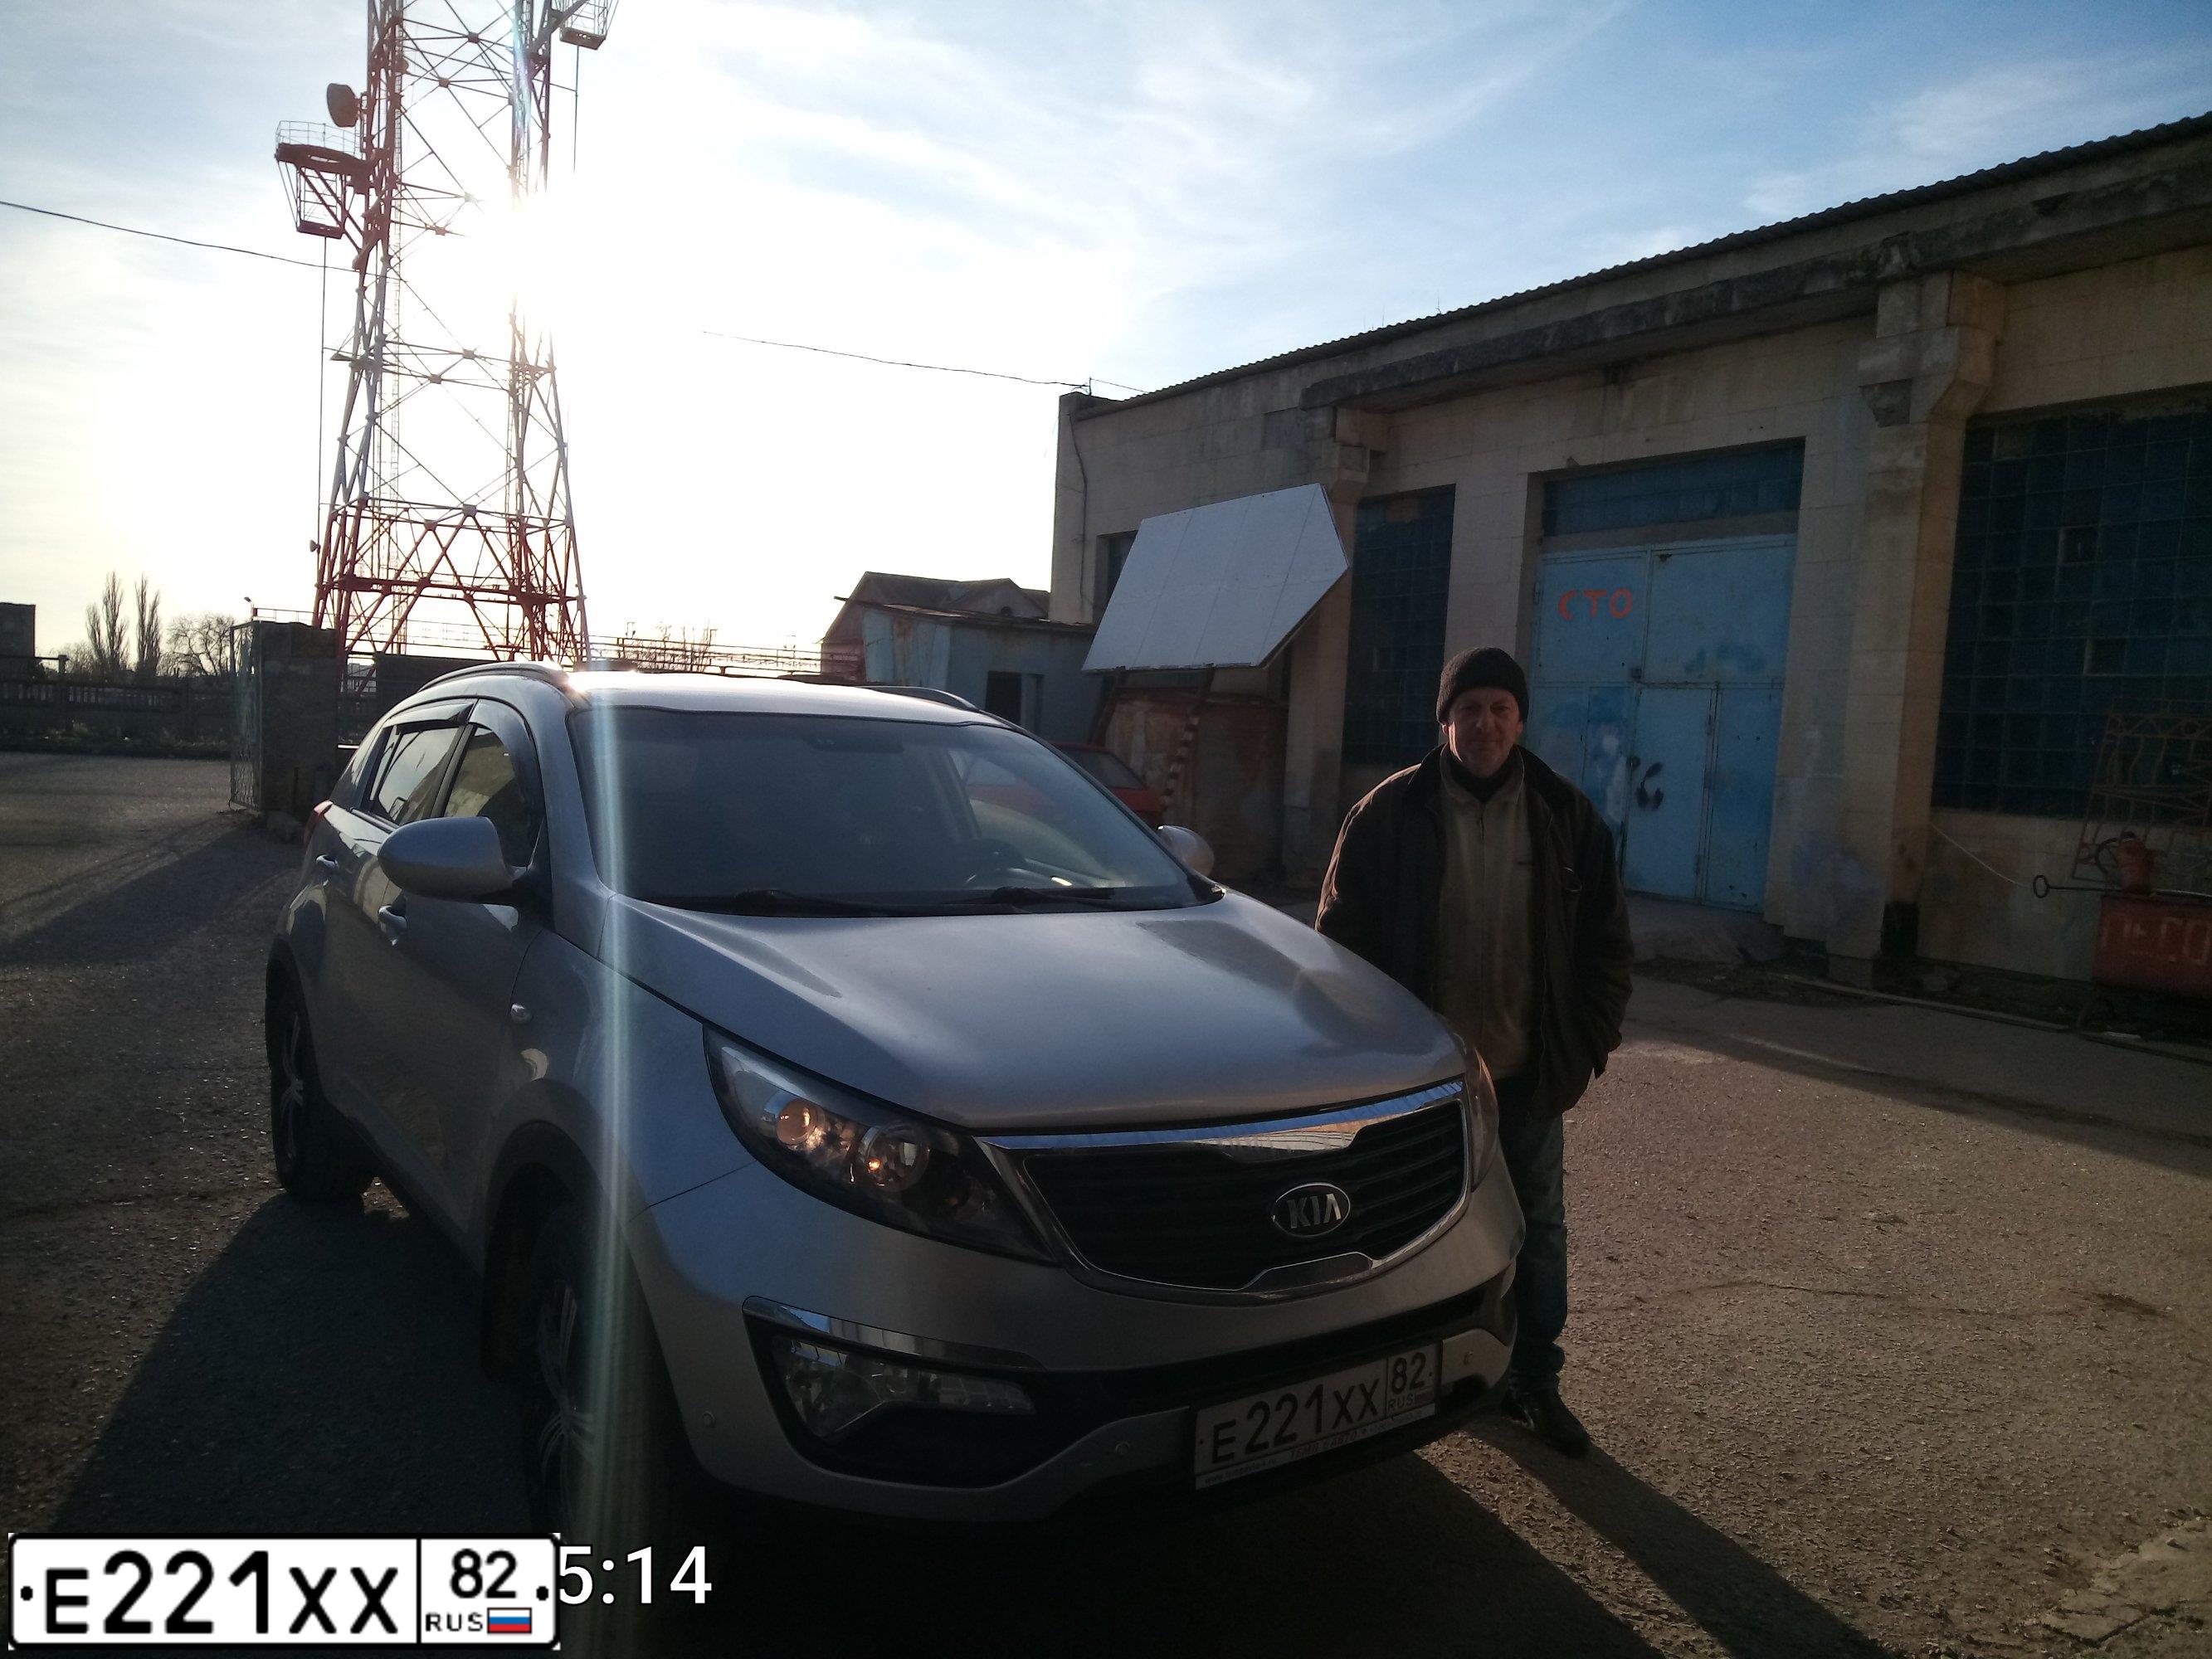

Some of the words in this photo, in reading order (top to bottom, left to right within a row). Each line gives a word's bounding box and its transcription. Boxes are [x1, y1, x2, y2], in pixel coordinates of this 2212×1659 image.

[1557, 587, 1633, 620] СТО
[1287, 1193, 1342, 1228] KIA
[1211, 1378, 1381, 1465] Е221ХХ
[1391, 1351, 1427, 1396] 82
[1387, 1393, 1415, 1413] RUS
